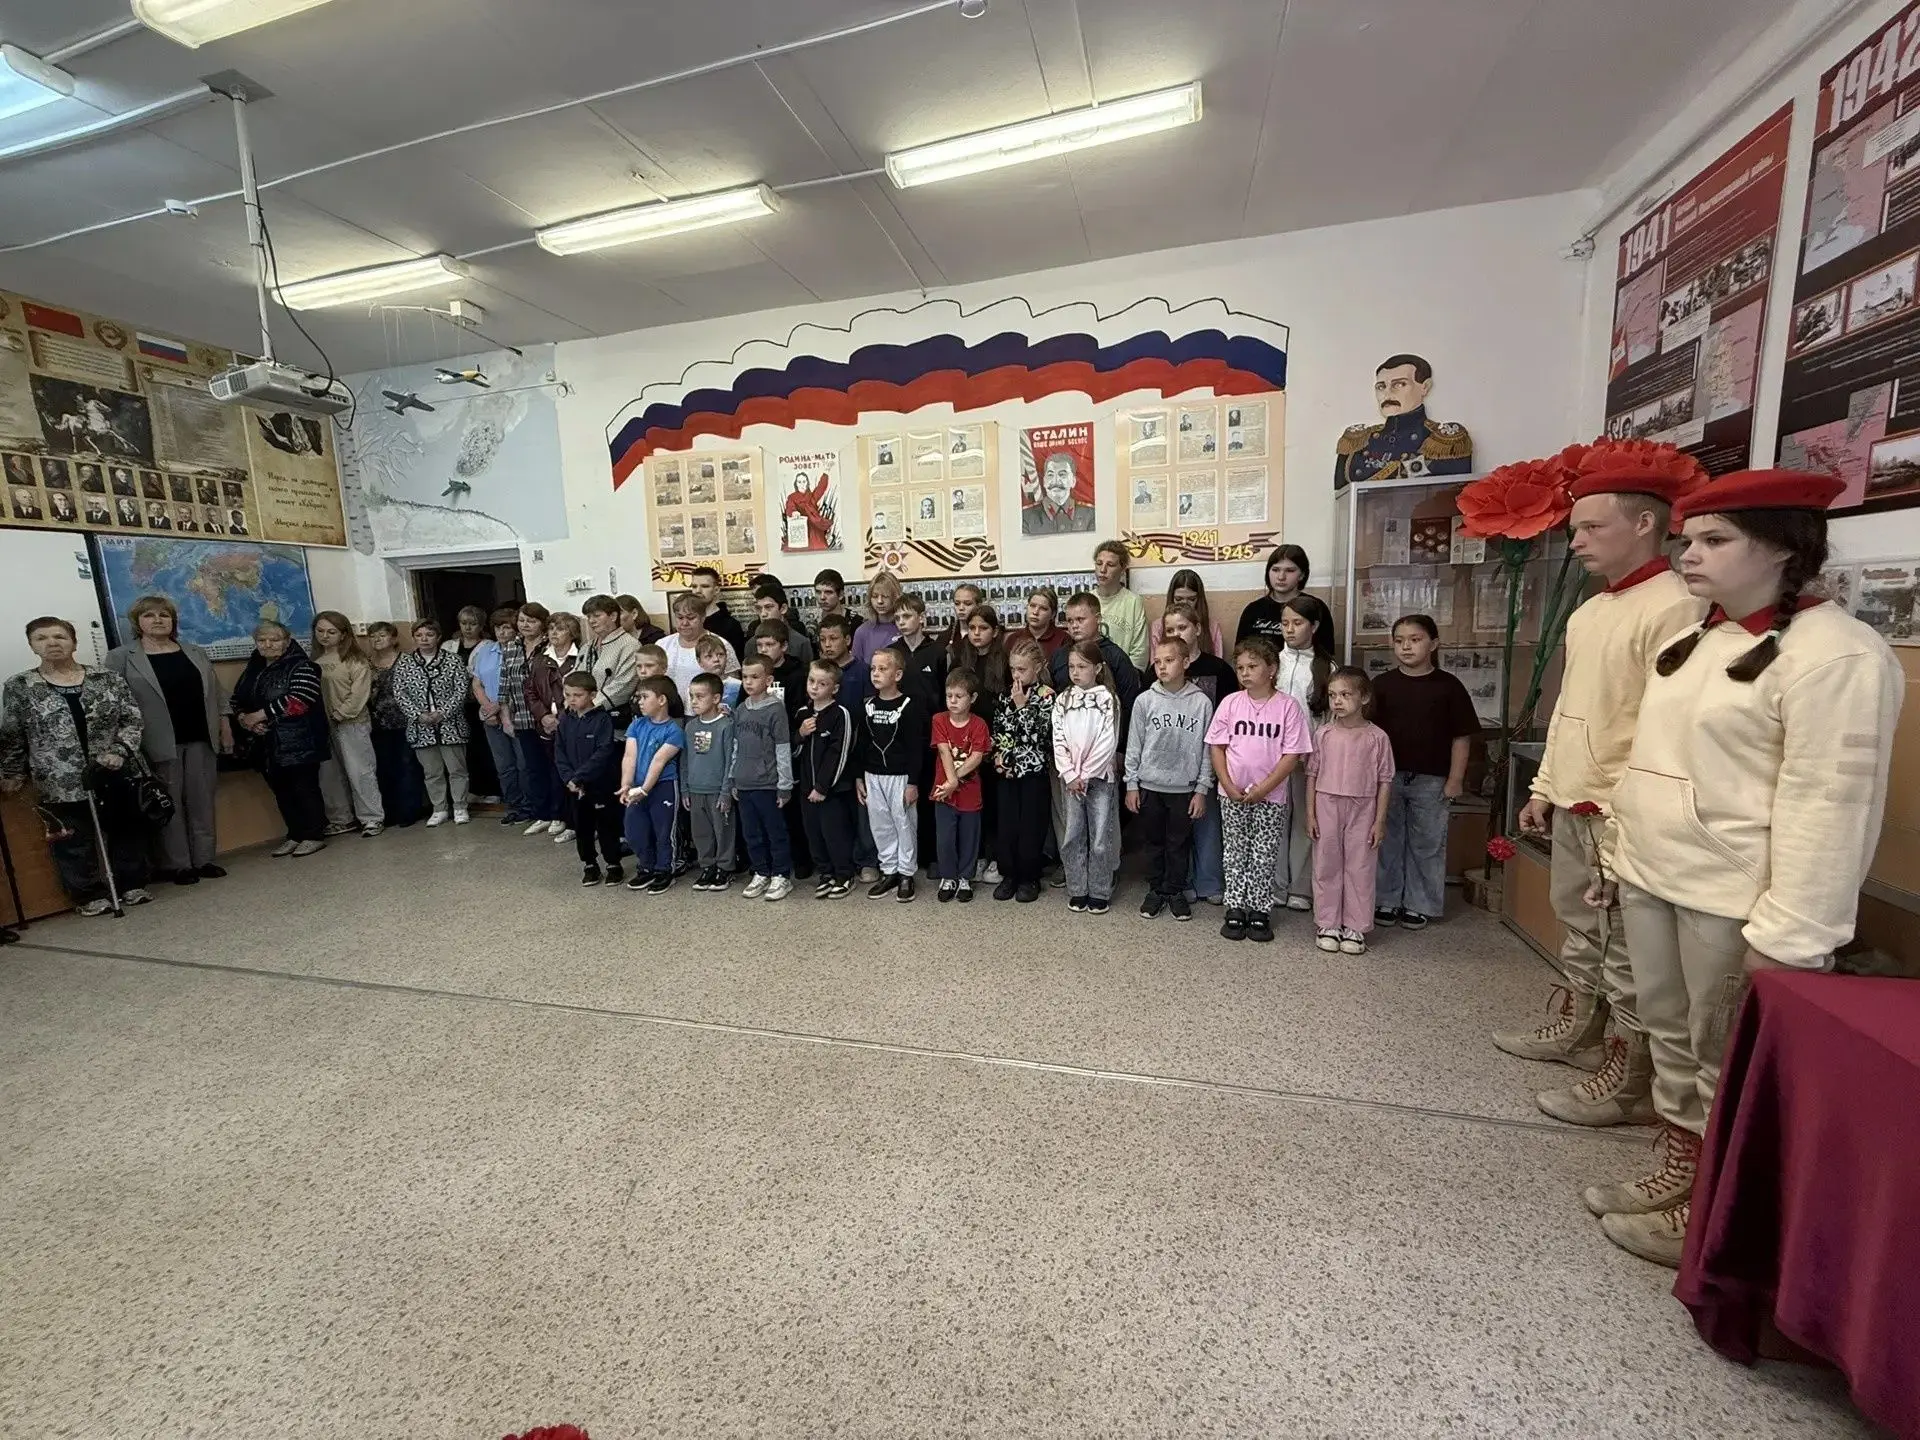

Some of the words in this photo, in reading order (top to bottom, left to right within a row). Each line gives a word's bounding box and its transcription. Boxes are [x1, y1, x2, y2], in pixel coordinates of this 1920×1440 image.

[1829, 4, 1920, 132] 1942
[1624, 203, 1672, 278] 1941
[1032, 426, 1088, 441] СТАЛИН
[778, 452, 836, 464] РОДИНА-МАТЬ
[793, 462, 820, 470] ЗОВЕТ!
[105, 538, 132, 546] МИР
[1180, 529, 1219, 547] 1941
[1212, 544, 1254, 561] 1945
[719, 572, 750, 586] 1945
[1151, 713, 1199, 733] BRNX
